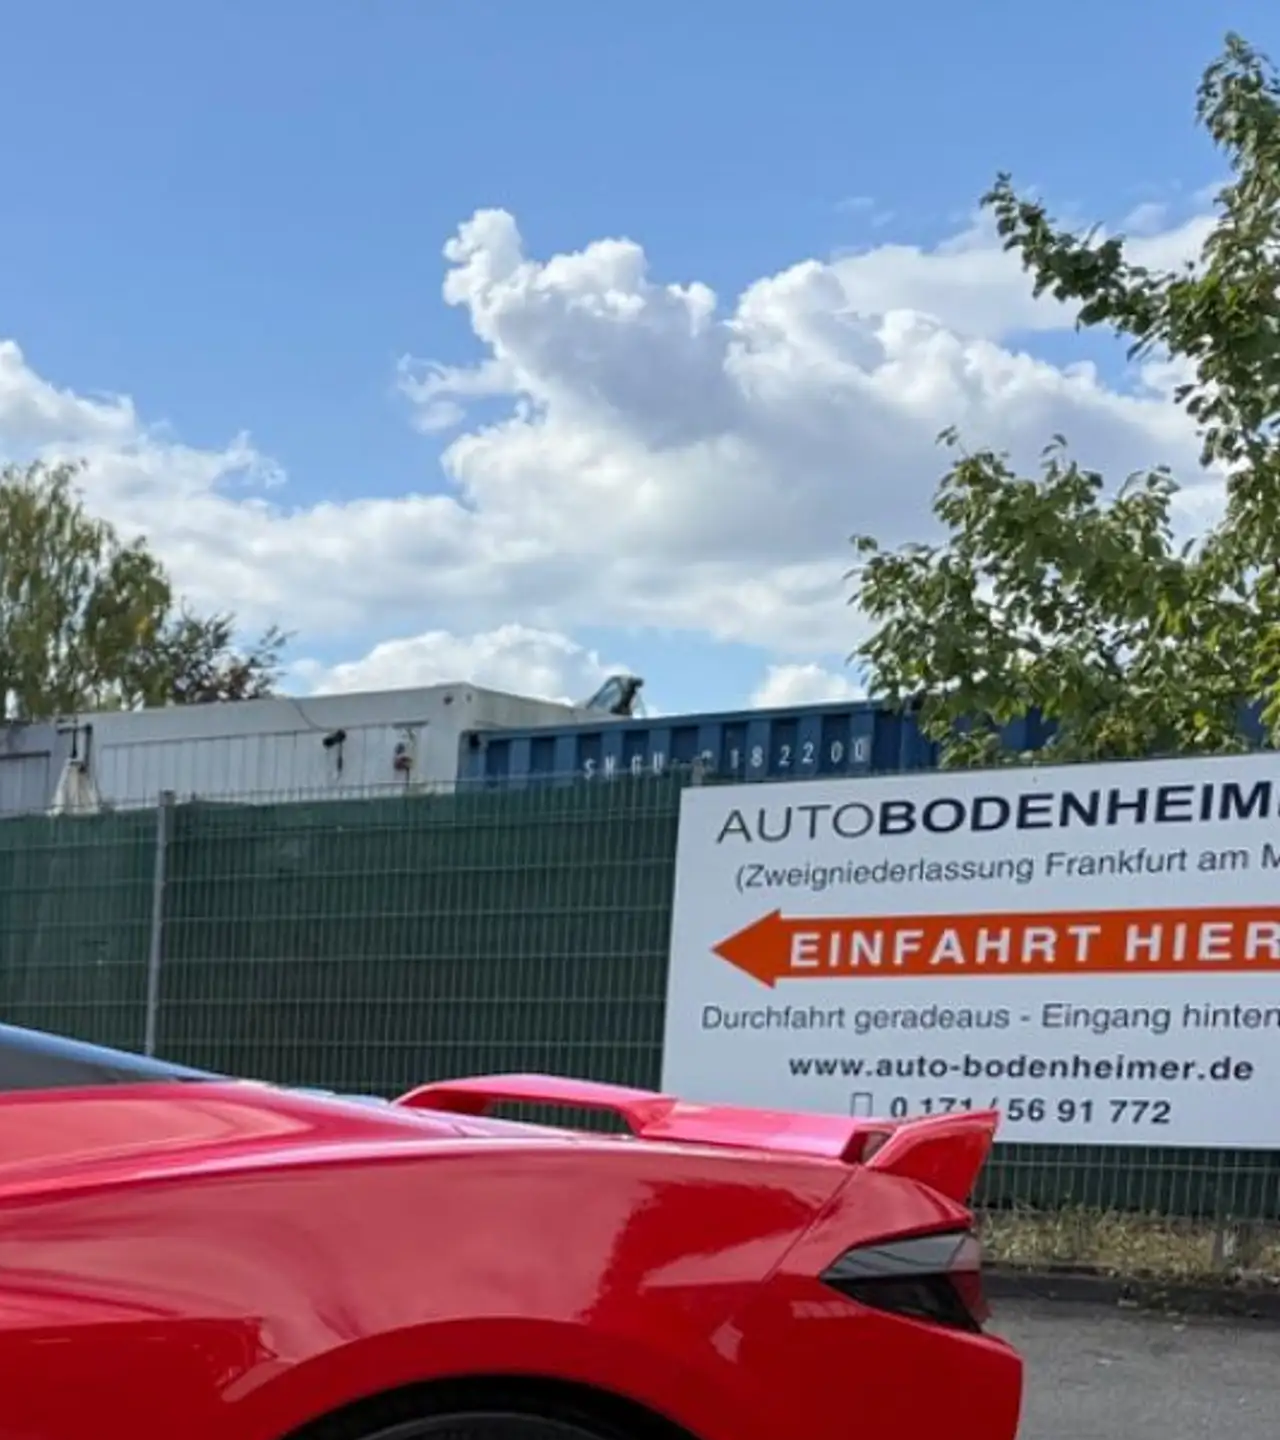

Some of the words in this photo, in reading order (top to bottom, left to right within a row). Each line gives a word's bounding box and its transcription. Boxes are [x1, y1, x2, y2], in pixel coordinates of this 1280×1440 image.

[716, 780, 1280, 844] AUTOBODENHEIM
[735, 854, 1035, 893] (Zweigniederlassung
[1045, 846, 1188, 877] Frankfurt
[1196, 847, 1249, 872] am
[790, 924, 1102, 968] EINFAHRT
[1124, 921, 1280, 962] HIER
[701, 1004, 846, 1031] Durchfahrt
[854, 1004, 1012, 1035] geradeaus
[1041, 1003, 1171, 1035] Eingang
[1182, 1002, 1280, 1029] hinten
[788, 1054, 1255, 1082] www.auto-bodenheimer.de
[1006, 1098, 1046, 1122] 56
[1056, 1099, 1093, 1123] 91
[1108, 1099, 1172, 1124] 772
